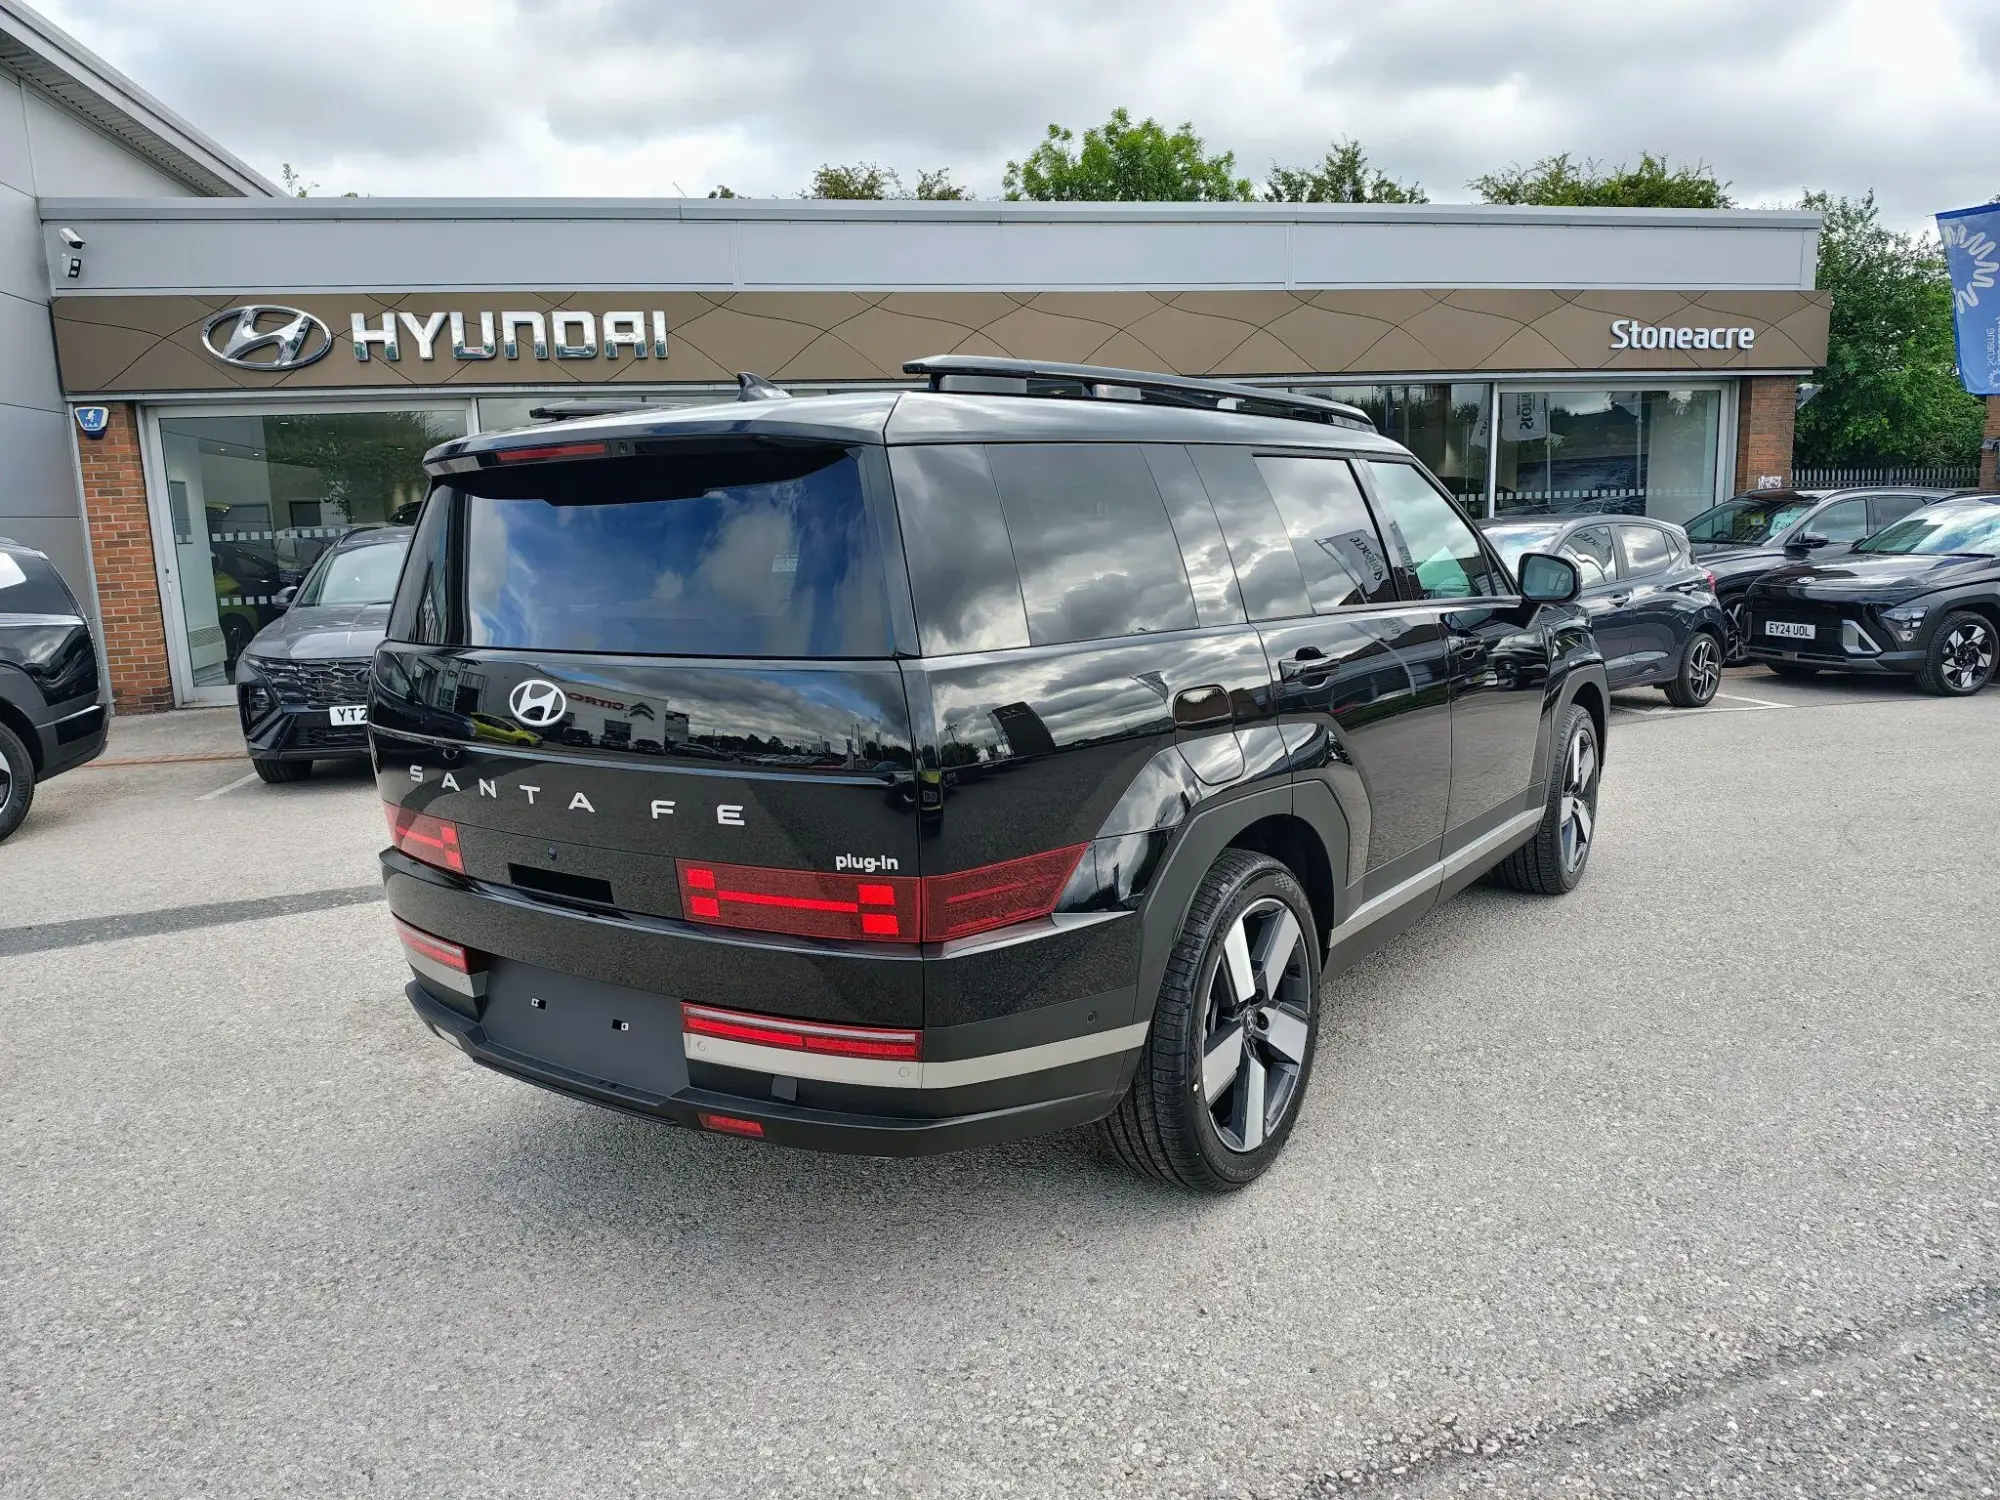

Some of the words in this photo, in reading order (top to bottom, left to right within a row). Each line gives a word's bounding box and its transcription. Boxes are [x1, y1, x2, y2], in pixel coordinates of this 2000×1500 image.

[350, 310, 668, 360] HYUNDAI
[1609, 319, 1755, 350] Stoneacre
[1769, 623, 1790, 635] EY24
[1793, 625, 1811, 637] UOL
[409, 765, 596, 813] SANTA
[651, 800, 746, 826] FE
